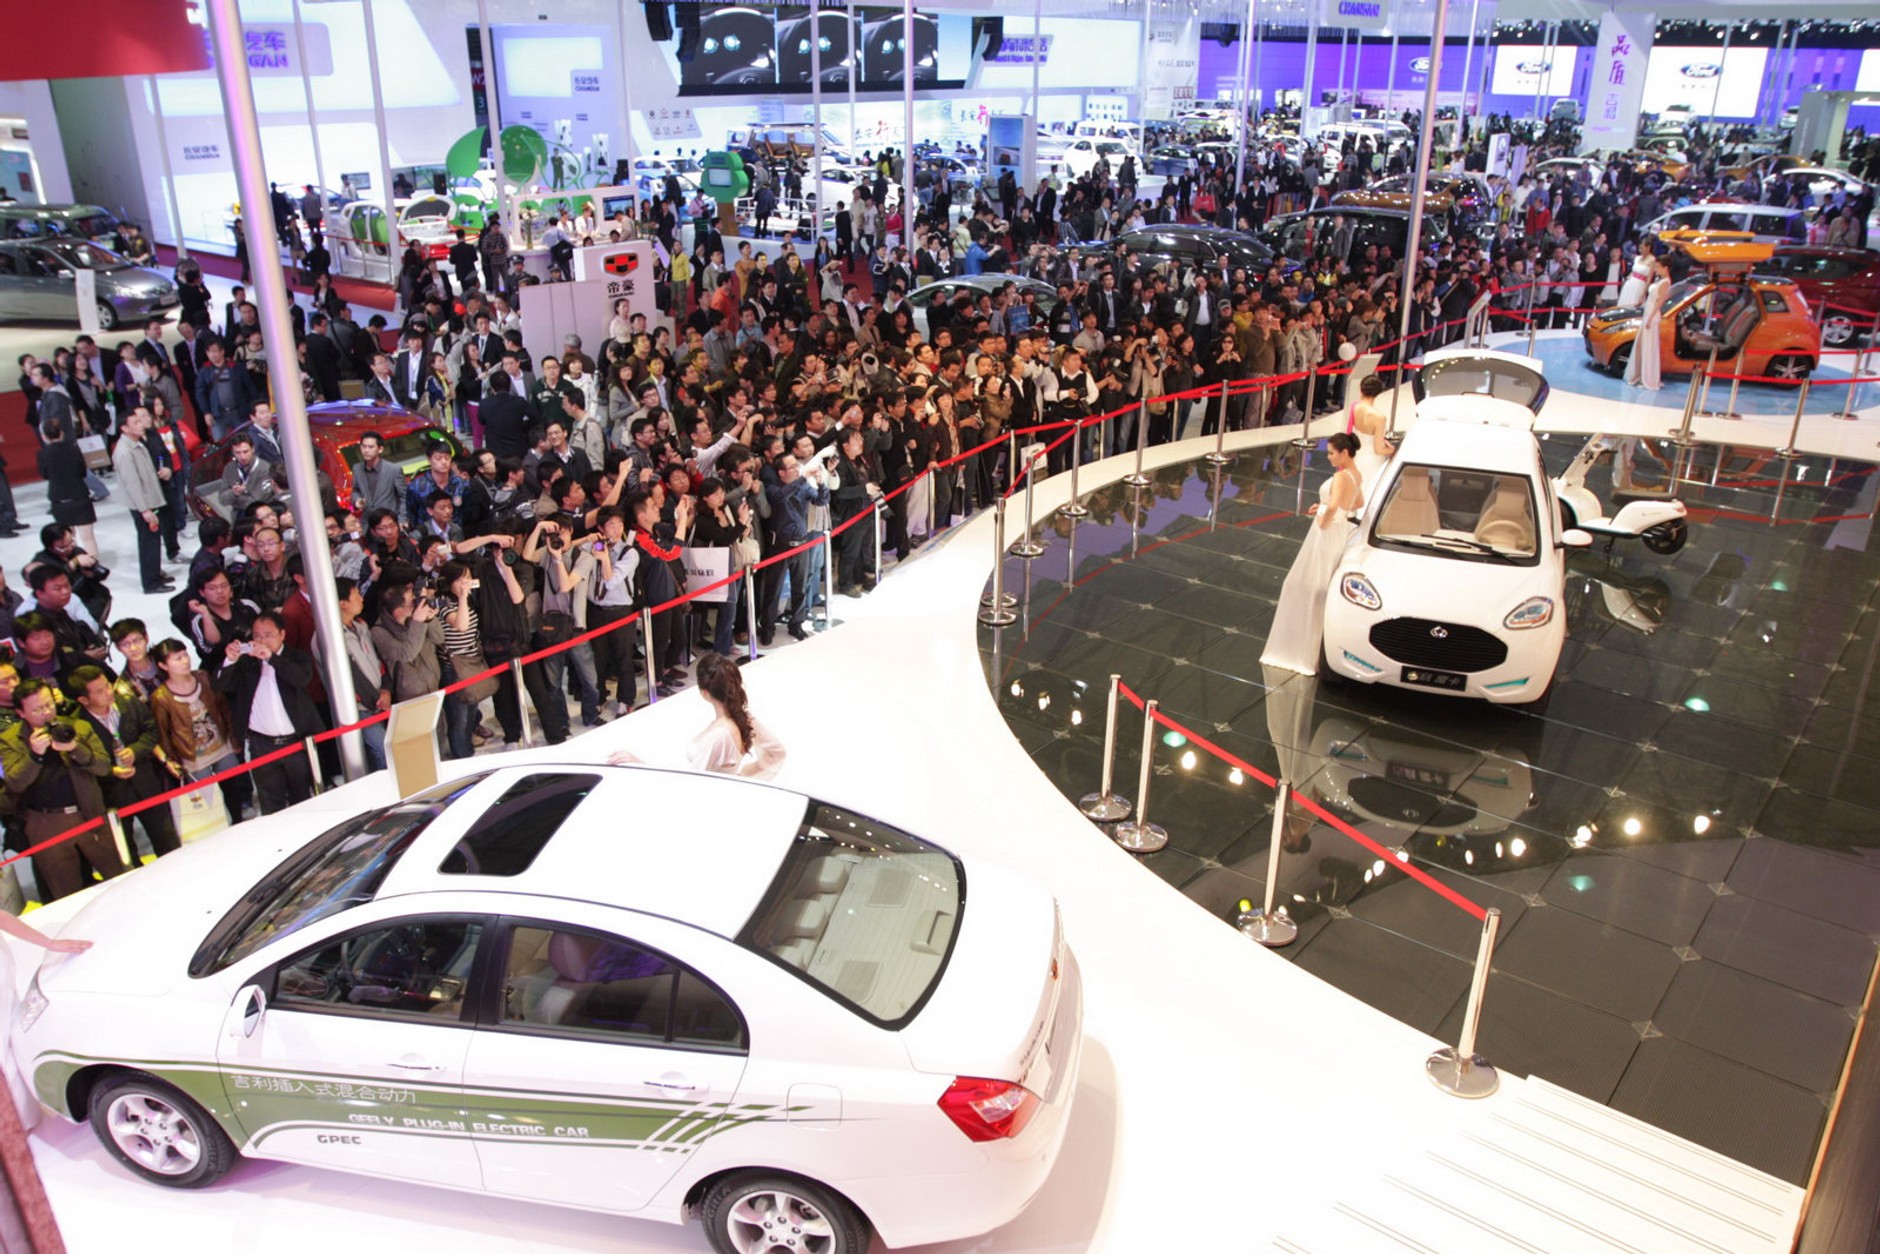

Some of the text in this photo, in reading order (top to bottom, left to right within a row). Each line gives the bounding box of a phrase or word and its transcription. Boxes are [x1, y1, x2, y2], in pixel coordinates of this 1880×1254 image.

[230, 1075, 417, 1104] 吉利插入式混合动力
[402, 1117, 465, 1131] PLUG-IN
[472, 1122, 546, 1136] ELECTRIC
[554, 1126, 589, 1138] CAR
[317, 1134, 362, 1145] GPEC
